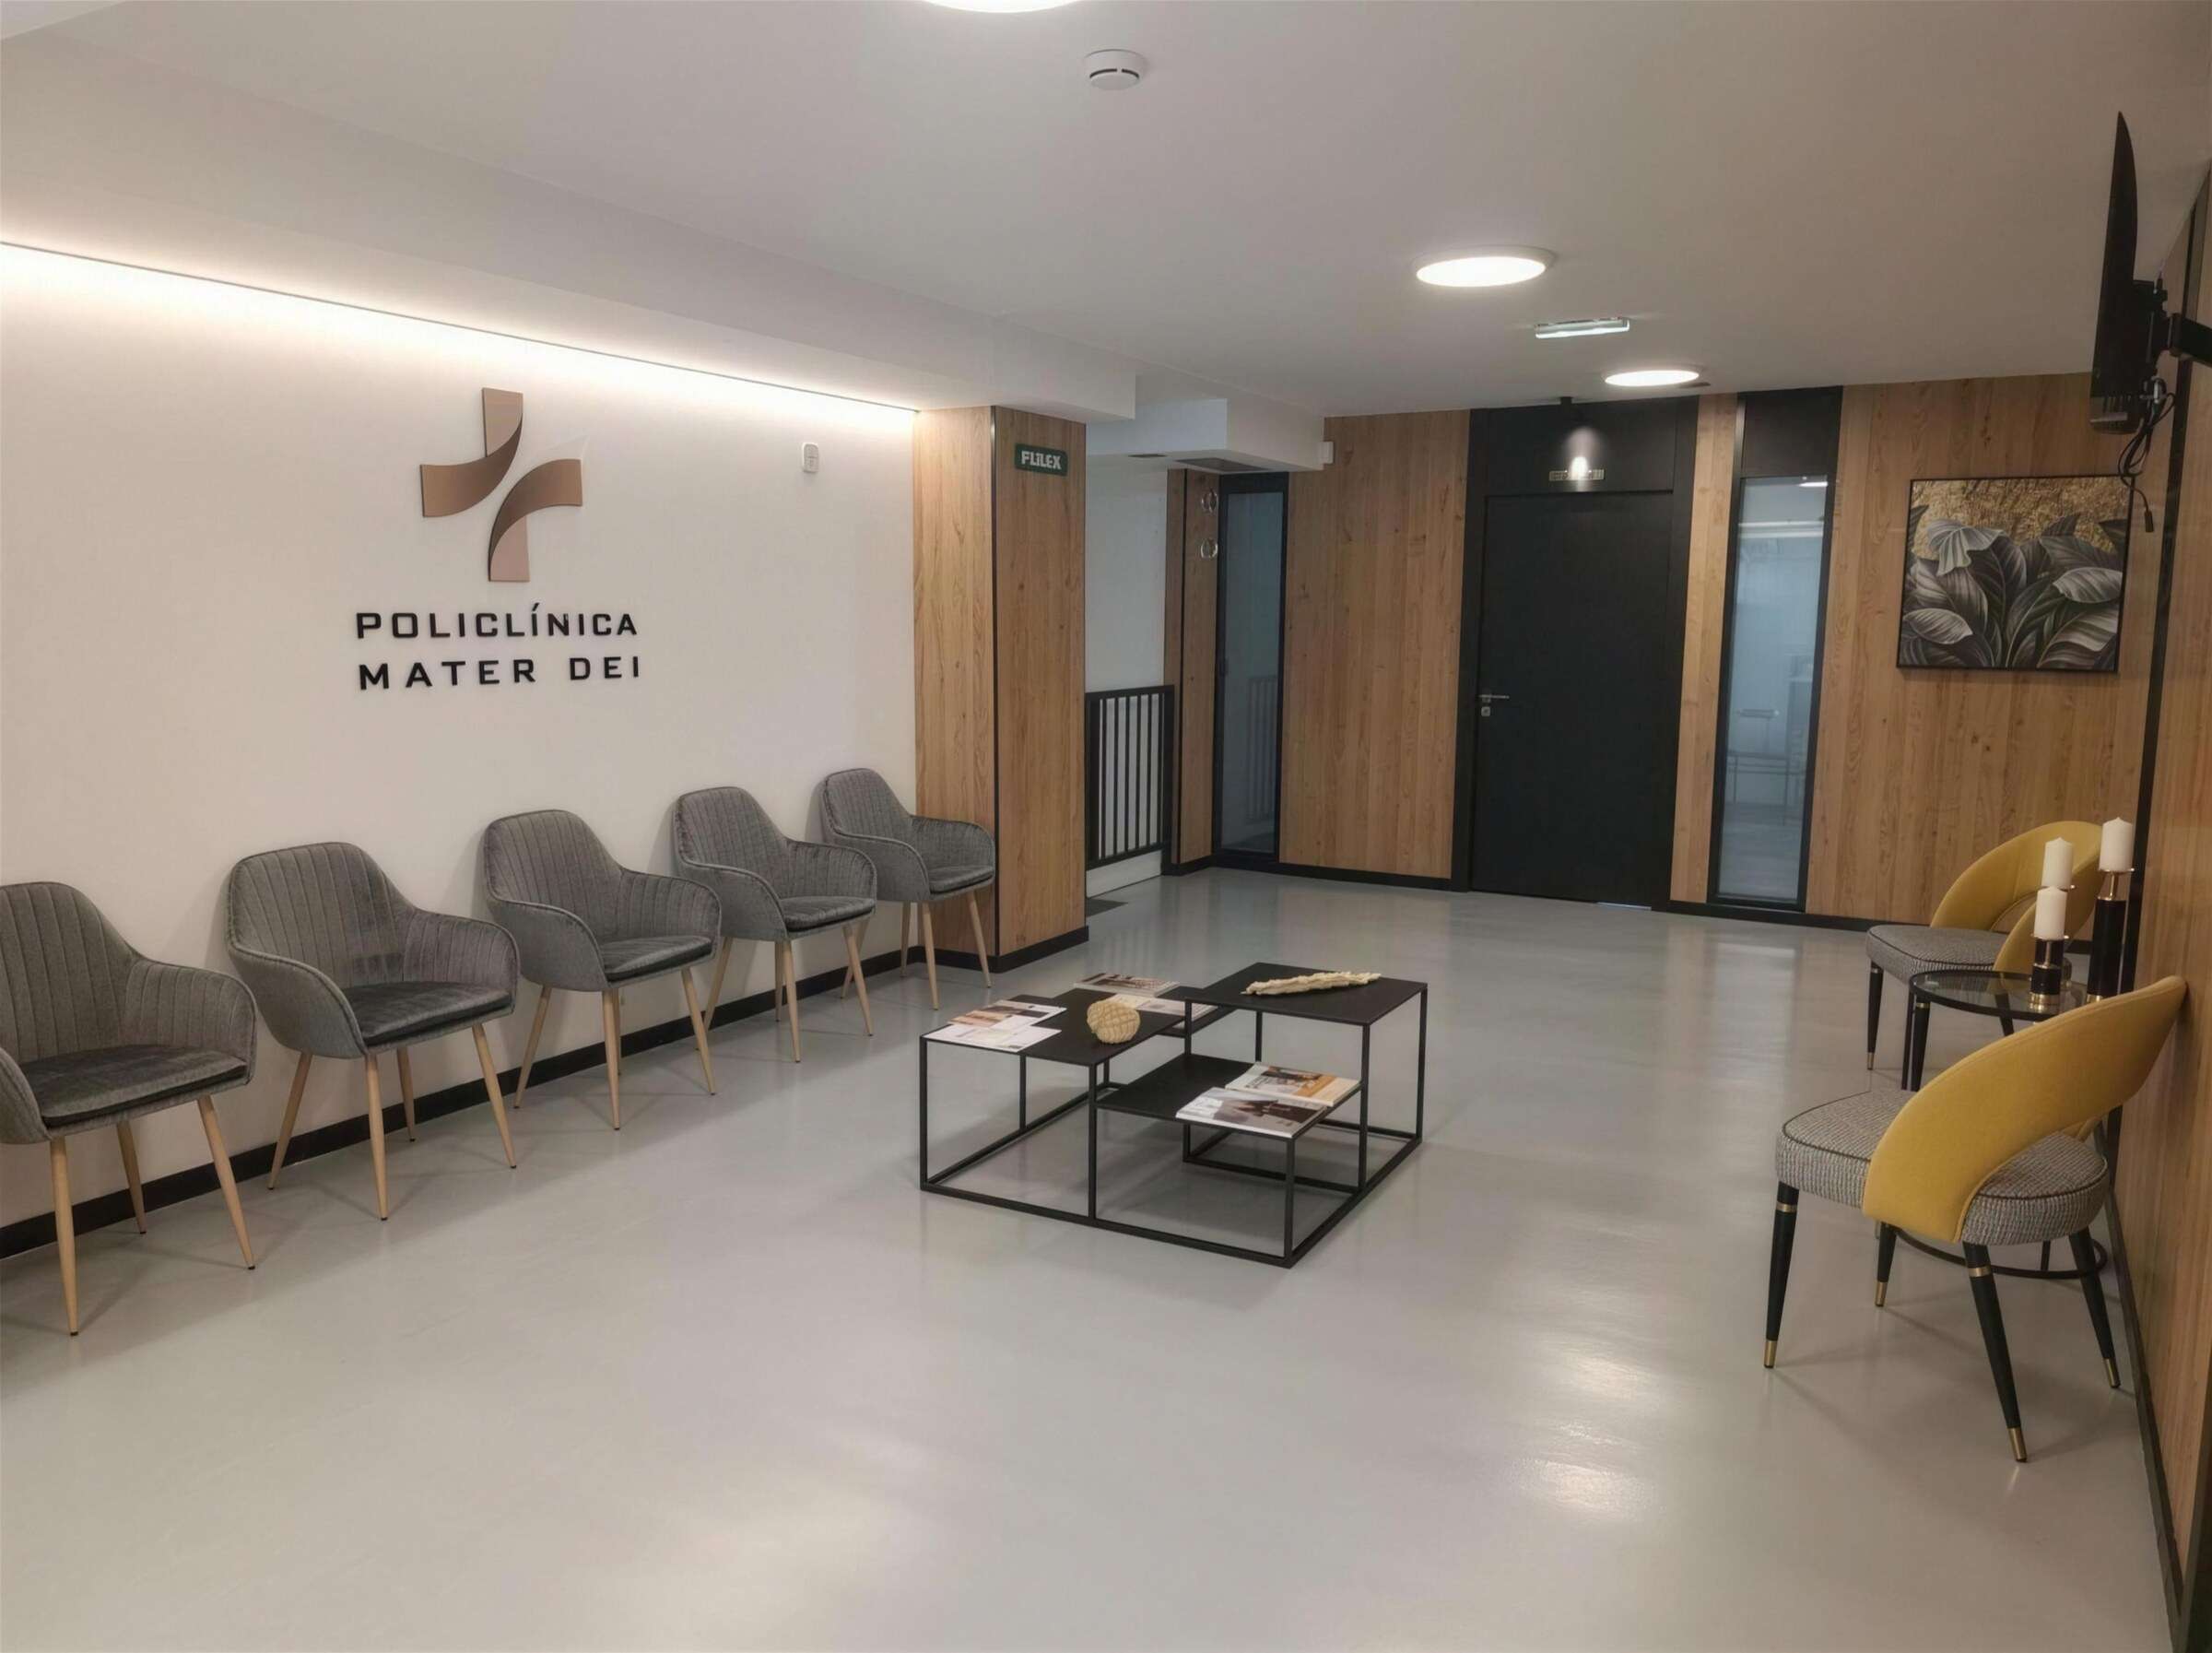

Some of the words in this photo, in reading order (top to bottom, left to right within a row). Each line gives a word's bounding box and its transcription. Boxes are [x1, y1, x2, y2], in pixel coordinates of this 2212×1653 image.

[356, 602, 638, 639] POLICLÍNICA
[359, 658, 536, 691] MATER
[569, 655, 640, 680] DEI
